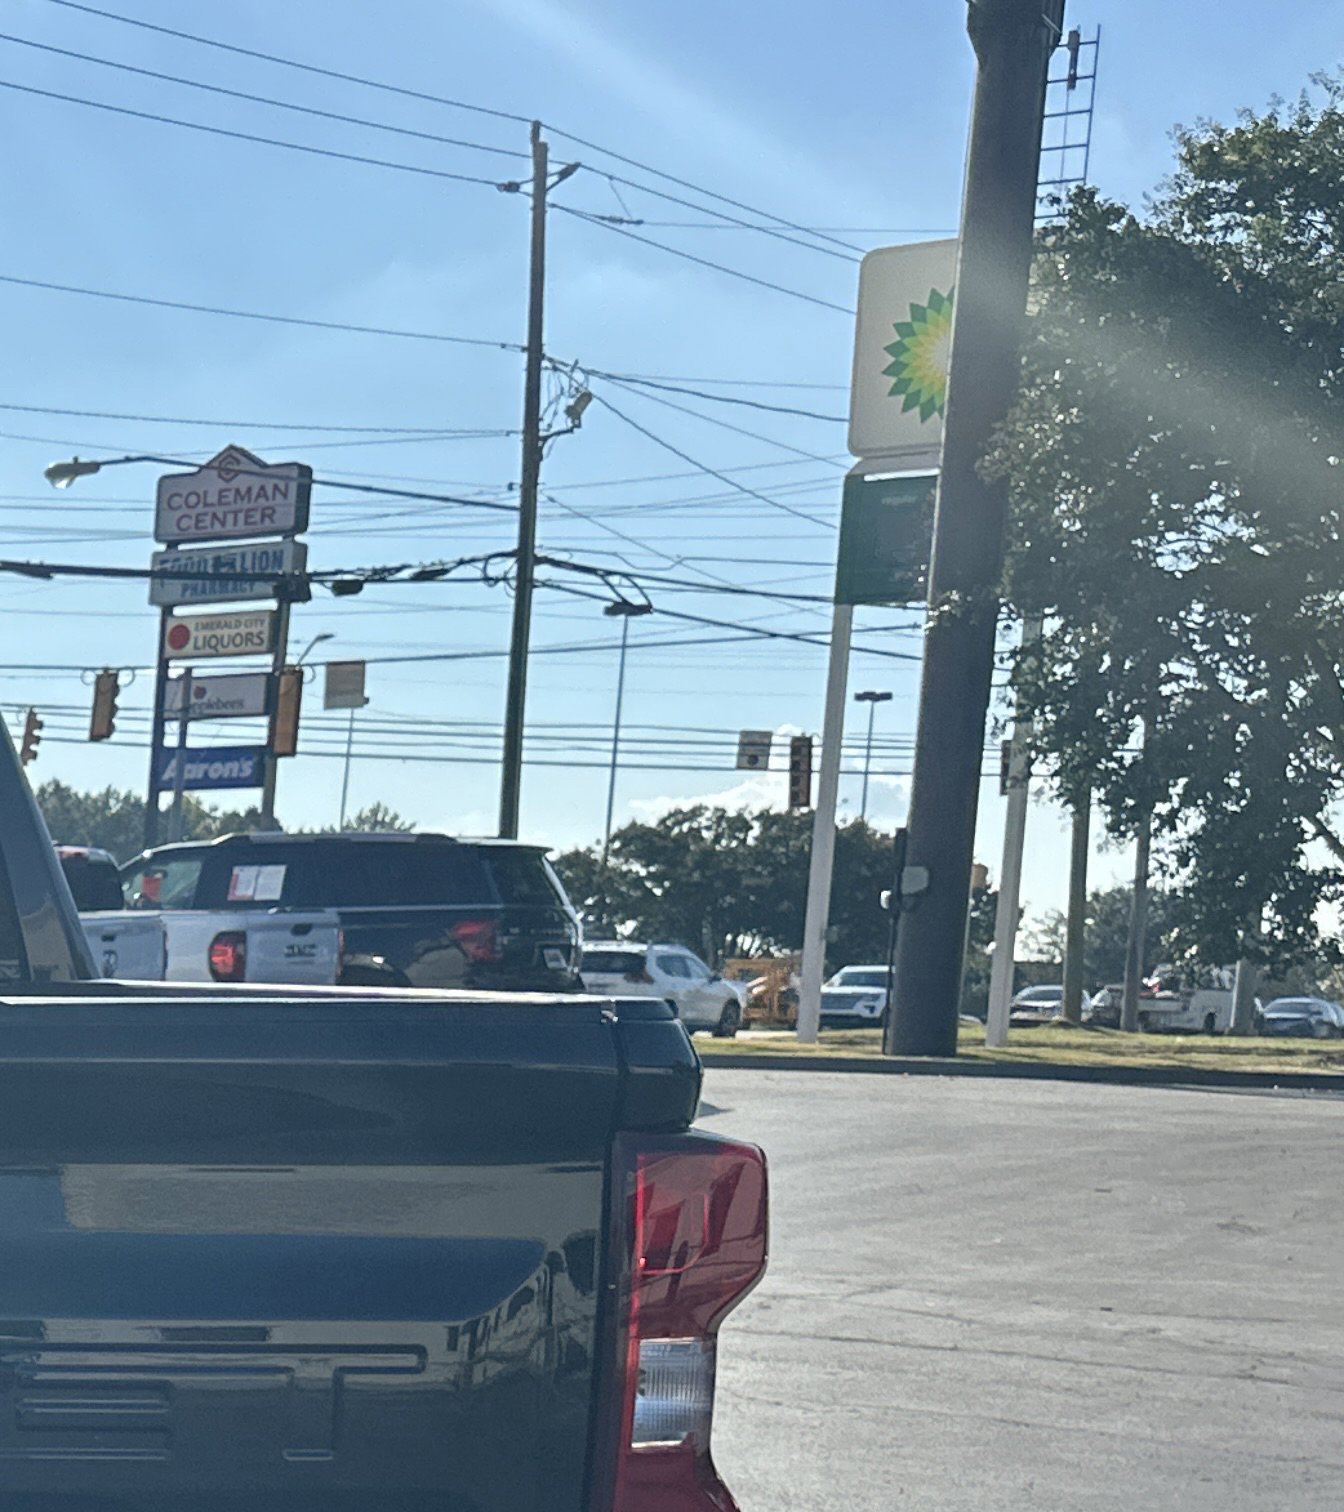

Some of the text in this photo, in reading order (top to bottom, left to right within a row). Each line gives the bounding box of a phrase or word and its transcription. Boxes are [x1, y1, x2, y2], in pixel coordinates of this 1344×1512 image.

[167, 482, 289, 511] COLEMAN
[176, 506, 277, 532] CENTER
[241, 550, 284, 573] LION
[180, 582, 255, 597] PHARMACY
[194, 618, 266, 631] EMERALD CITY
[193, 631, 265, 653] LIQUORS
[163, 757, 254, 781] Aaron's
